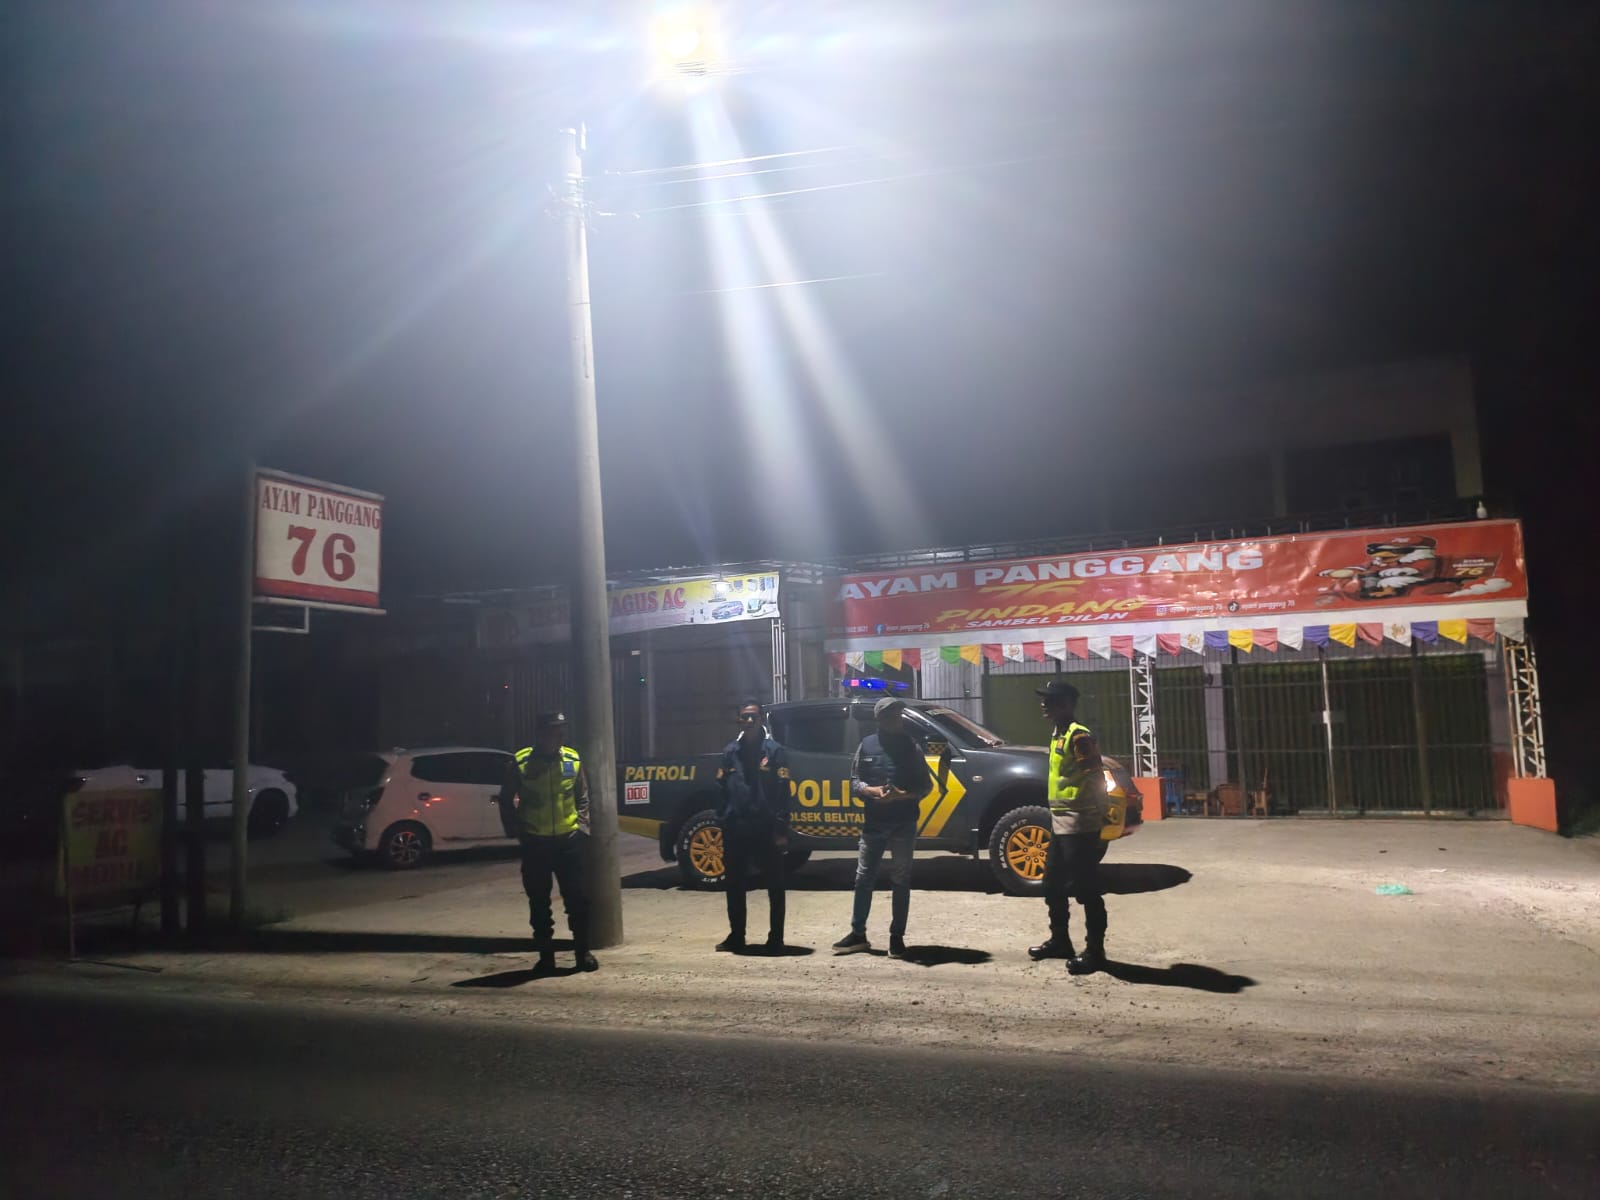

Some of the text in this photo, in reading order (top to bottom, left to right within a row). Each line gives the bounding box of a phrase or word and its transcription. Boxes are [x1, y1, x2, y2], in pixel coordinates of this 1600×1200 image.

[262, 485, 381, 530] AYAM PANGGANG
[287, 524, 356, 582] 76
[841, 549, 1264, 600] AYAM PANGGANG
[662, 587, 686, 611] AC
[936, 597, 1150, 623] PINDANG
[965, 616, 1051, 629] SAMBEL
[1057, 611, 1130, 623] DILAN
[624, 765, 697, 782] PATROLI
[627, 787, 648, 799] 110
